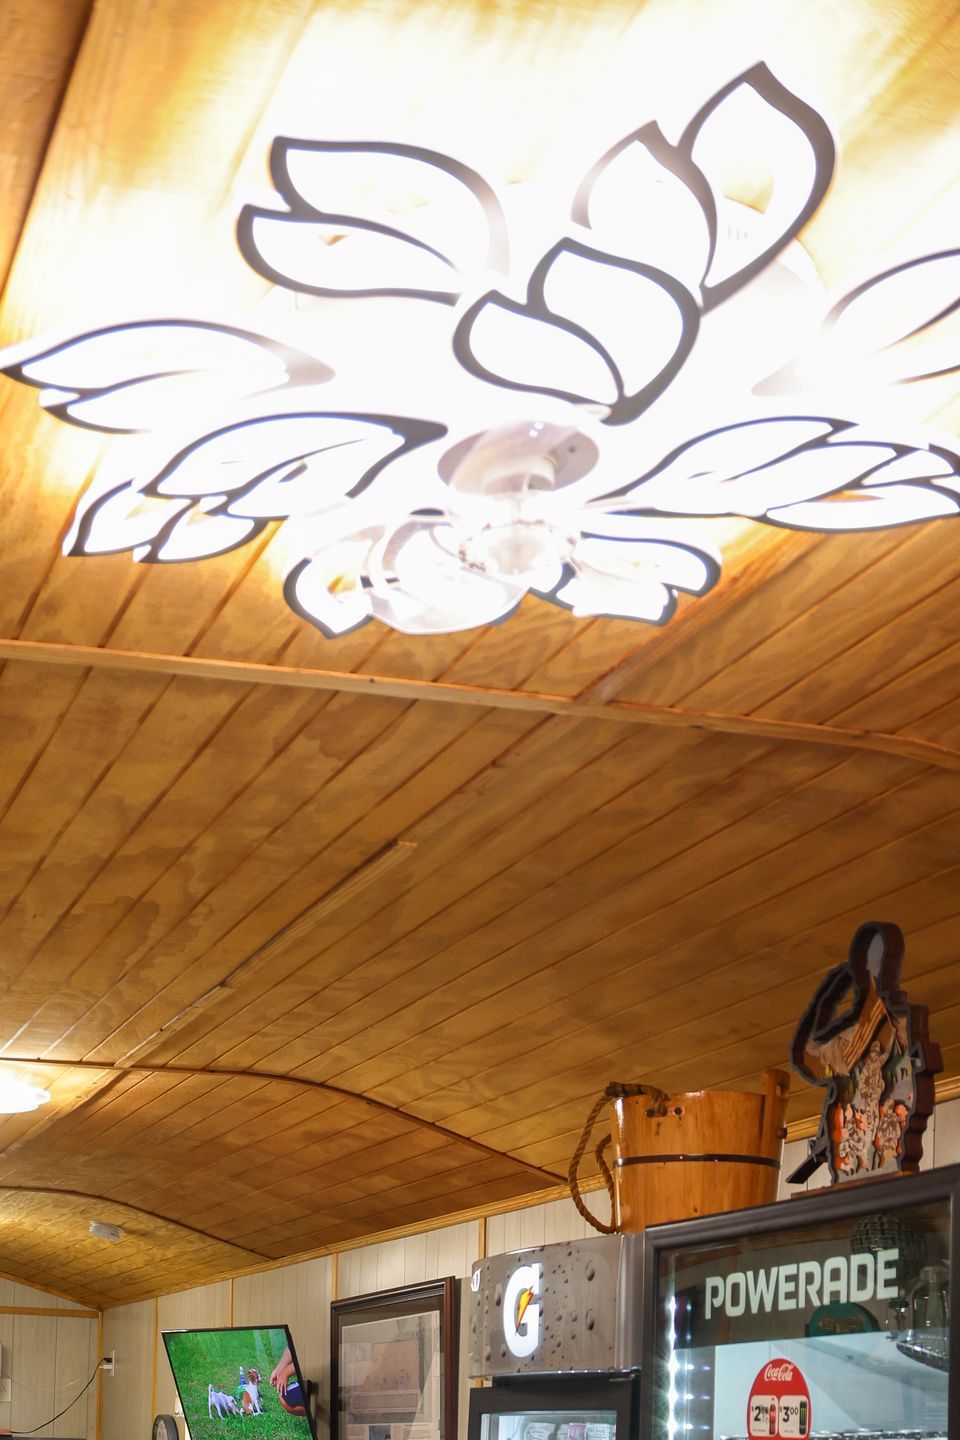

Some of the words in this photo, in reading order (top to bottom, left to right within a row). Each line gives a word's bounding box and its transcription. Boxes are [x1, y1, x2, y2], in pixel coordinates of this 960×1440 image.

[503, 1263, 542, 1358] G
[705, 1248, 899, 1320] POWERADE
[764, 1363, 794, 1381] Coca-Cola
